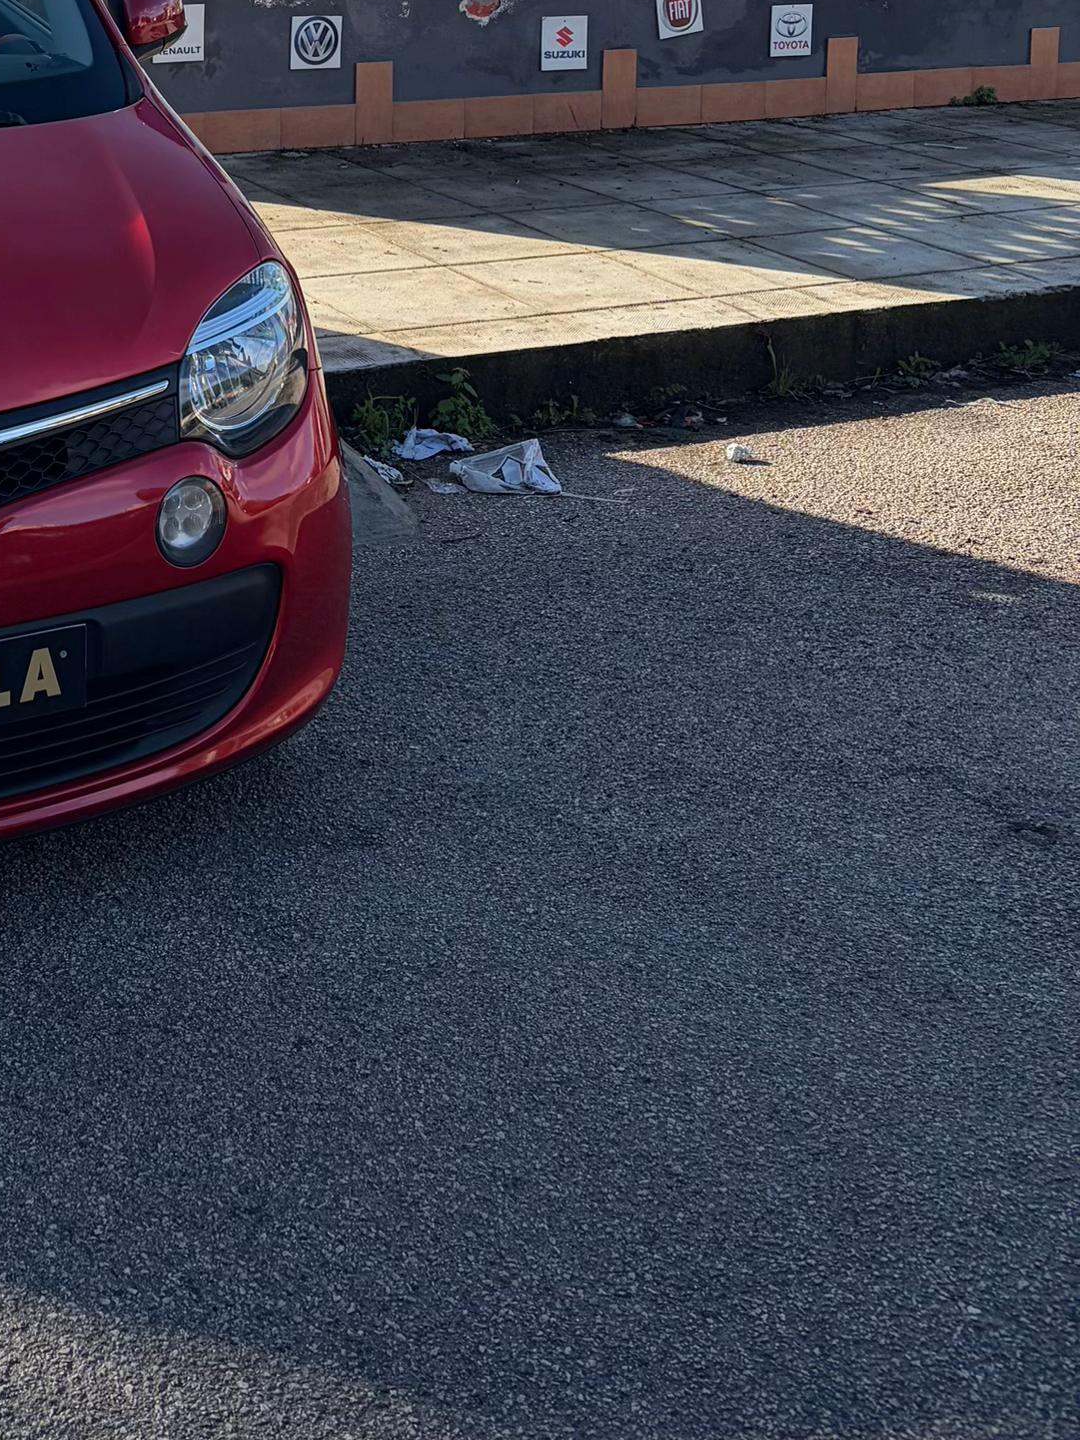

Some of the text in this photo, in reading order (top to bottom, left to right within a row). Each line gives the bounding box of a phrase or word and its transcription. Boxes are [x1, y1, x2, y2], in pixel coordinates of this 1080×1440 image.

[773, 41, 809, 50] TOYOTA
[161, 46, 201, 56] ENAULT
[544, 49, 586, 59] SUZUKI
